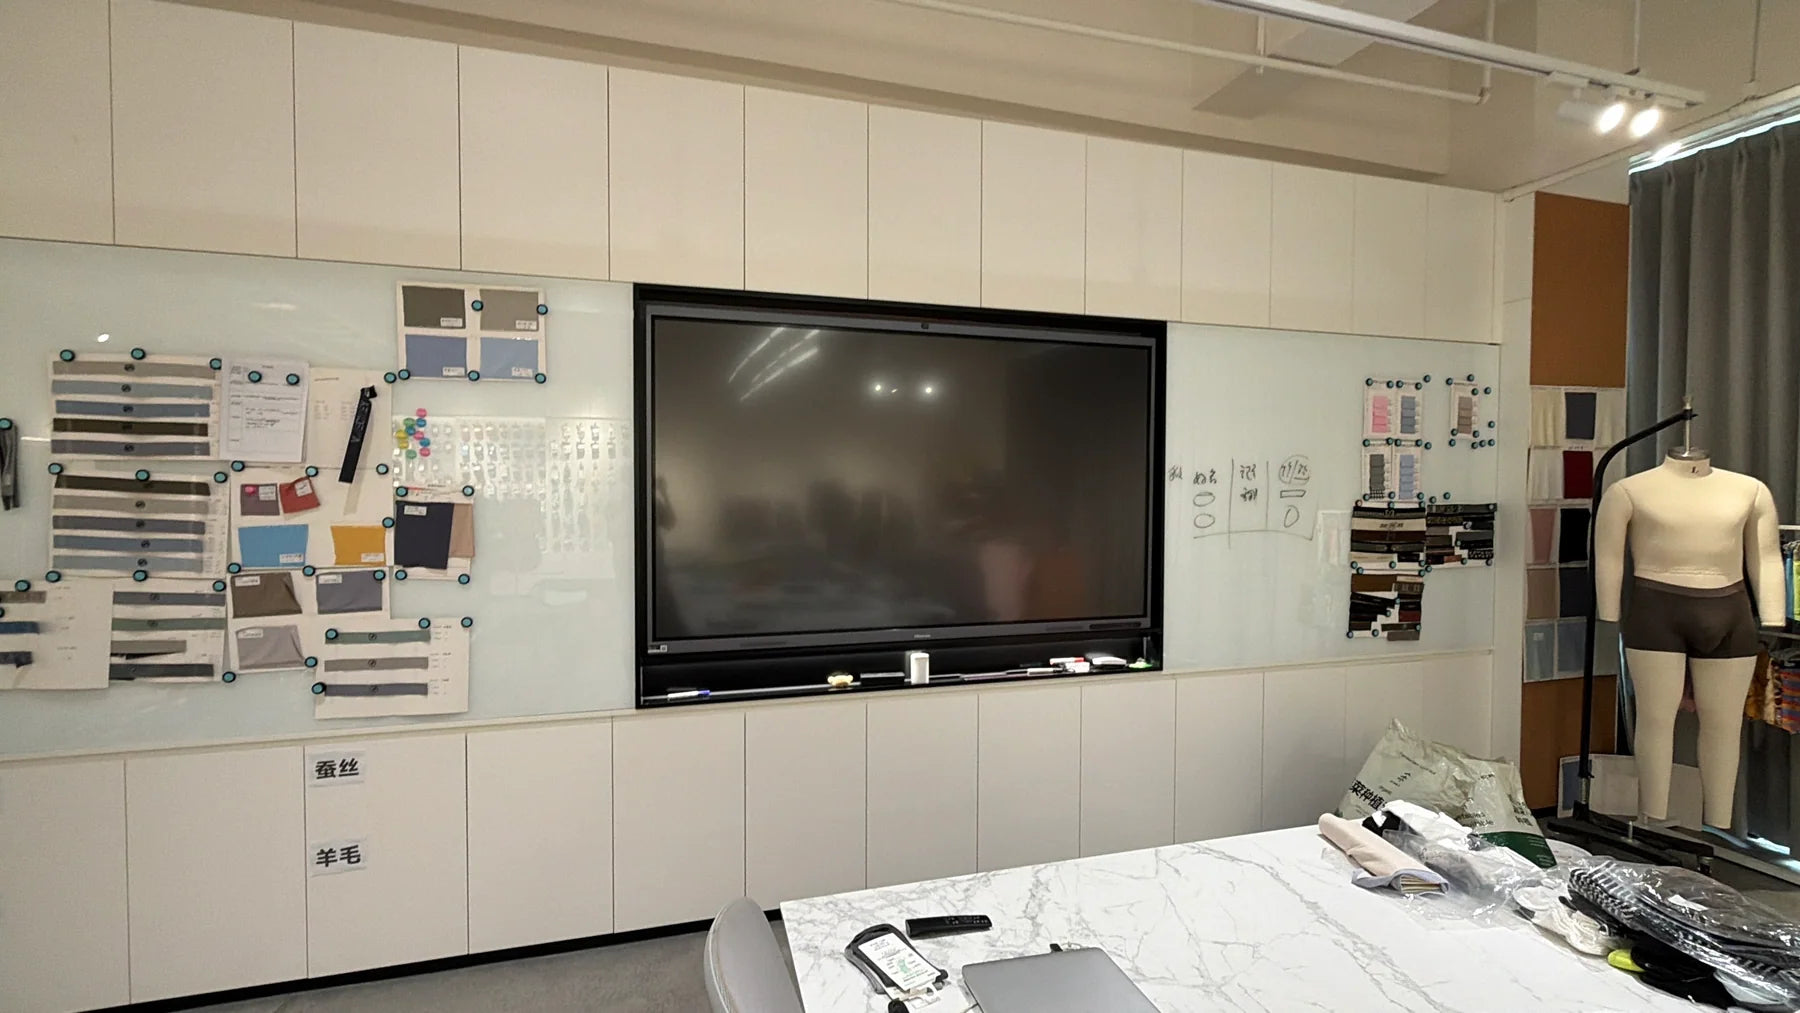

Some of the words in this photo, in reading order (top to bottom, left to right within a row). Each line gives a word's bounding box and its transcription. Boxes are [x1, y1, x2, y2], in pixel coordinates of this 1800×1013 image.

[315, 758, 359, 779] 蚕丝
[1349, 779, 1387, 810] 菜种植
[316, 845, 361, 867] 羊毛
